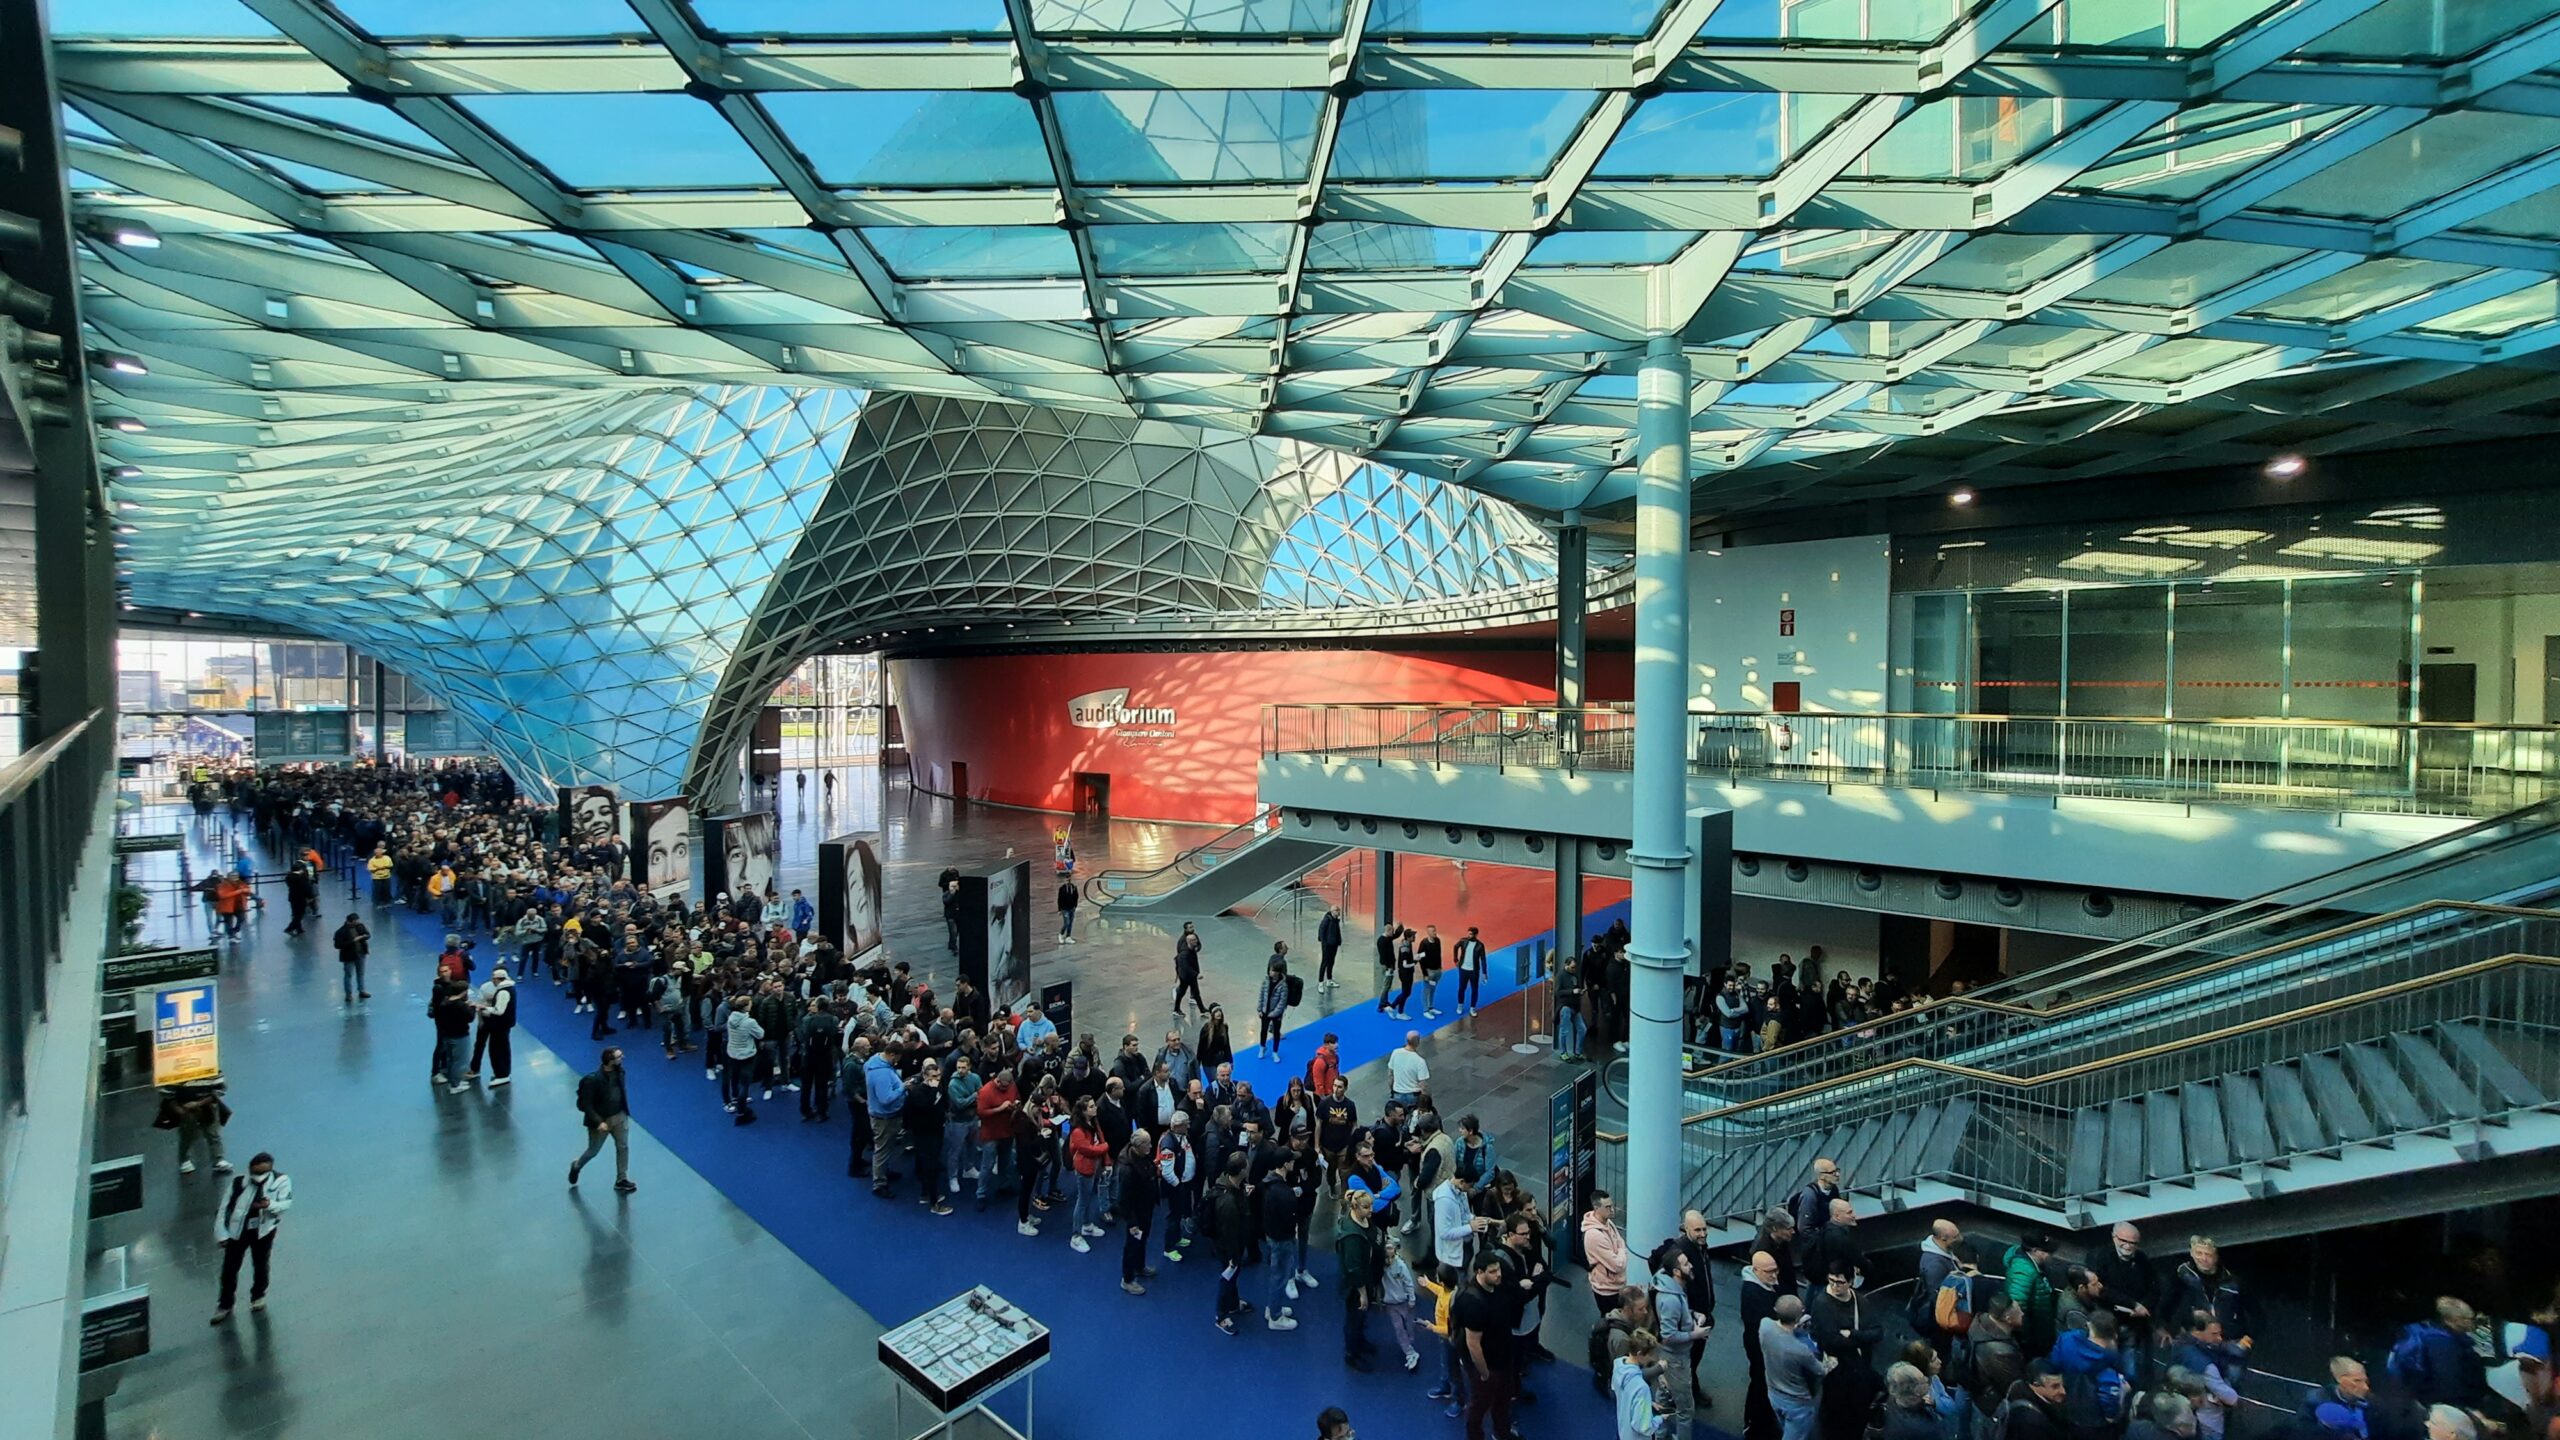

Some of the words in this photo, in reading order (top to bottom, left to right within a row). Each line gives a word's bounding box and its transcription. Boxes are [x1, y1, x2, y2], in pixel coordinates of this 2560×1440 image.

[1076, 703, 1175, 724] auditorium
[108, 958, 173, 973] Business
[179, 952, 213, 964] Point
[165, 989, 204, 1026] T
[158, 1022, 214, 1042] TABACCHI
